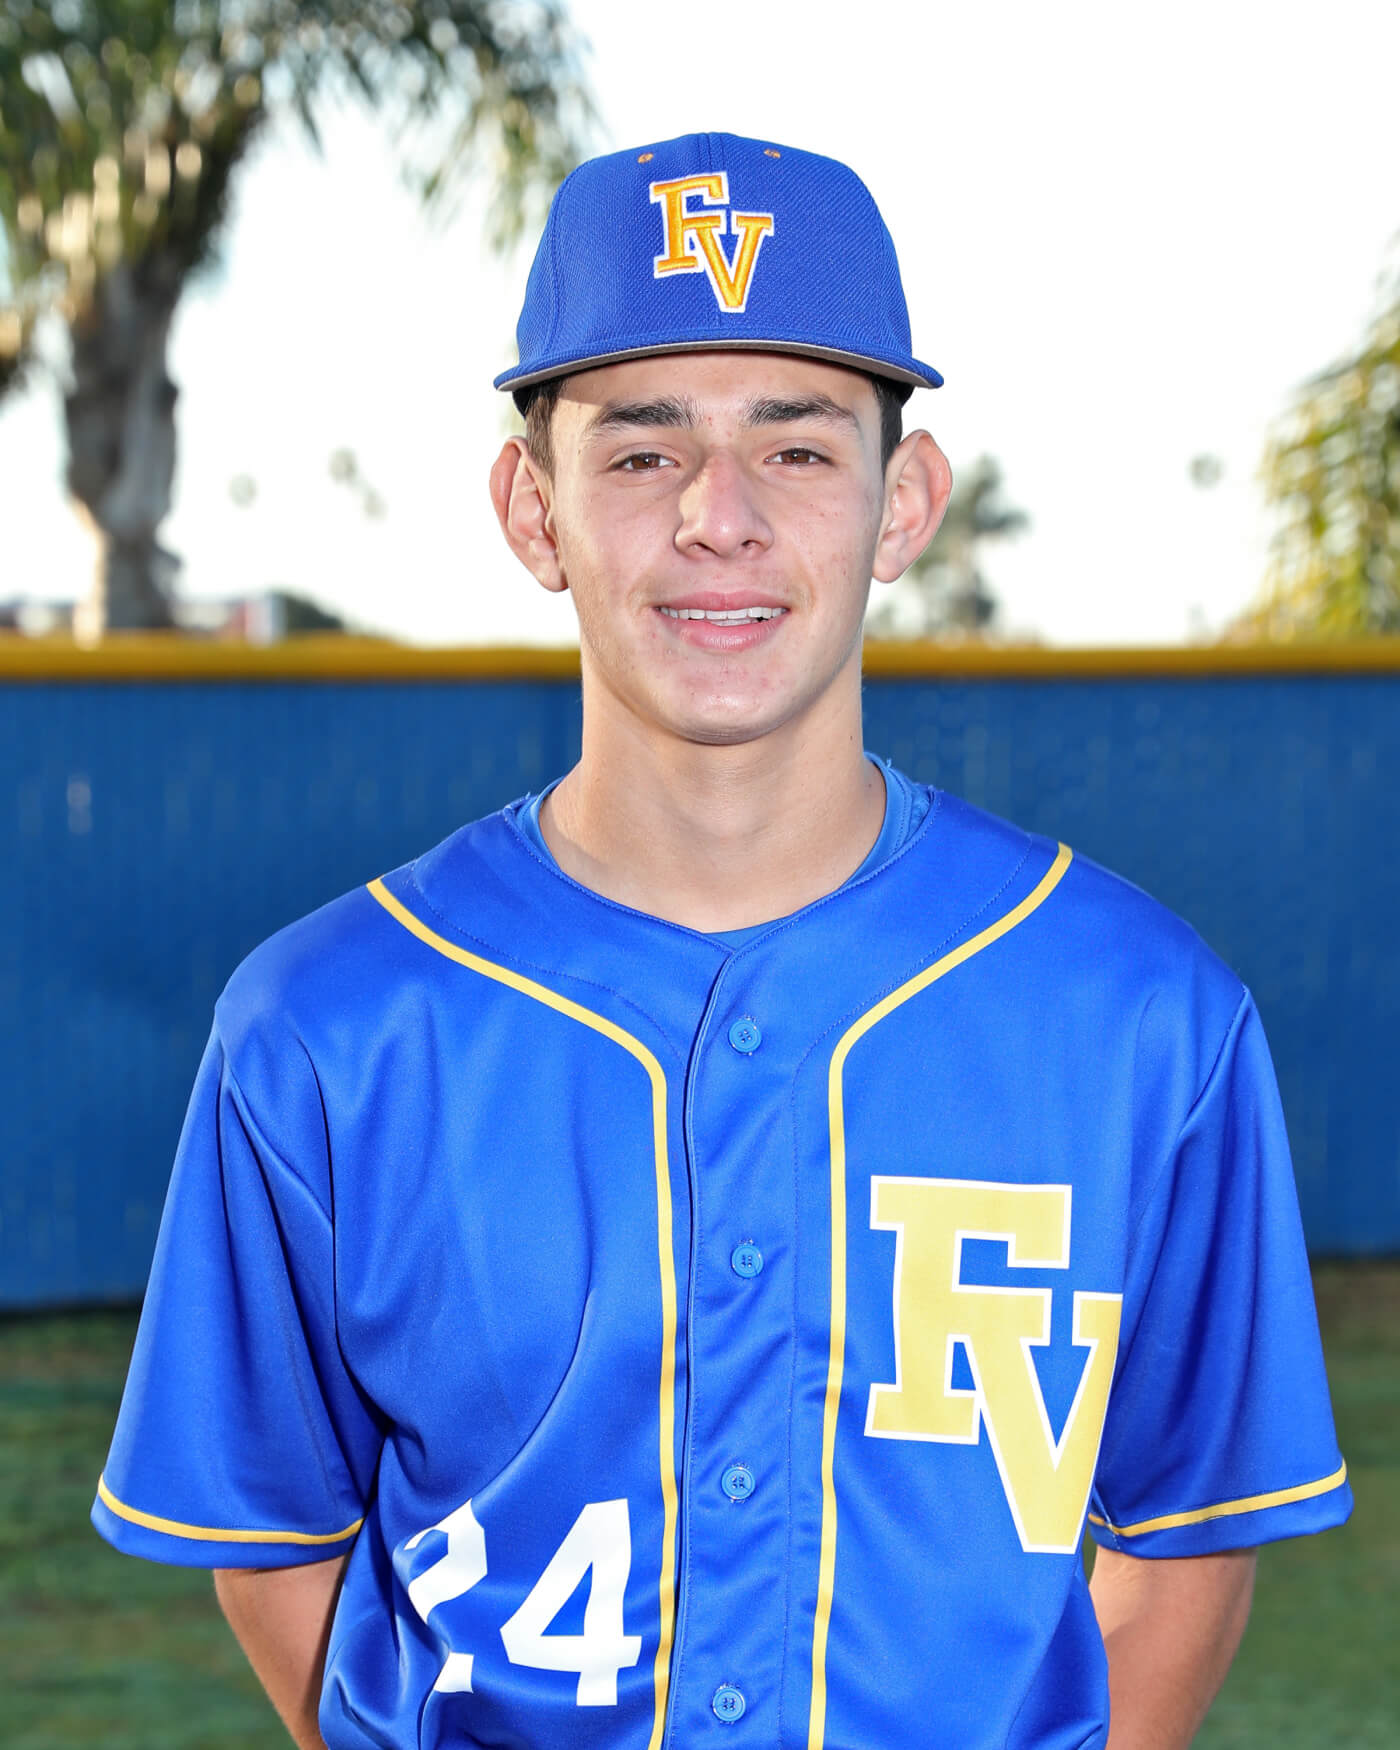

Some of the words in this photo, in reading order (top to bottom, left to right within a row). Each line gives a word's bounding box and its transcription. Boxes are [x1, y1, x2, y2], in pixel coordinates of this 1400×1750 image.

[649, 171, 775, 314] FV
[864, 1175, 1123, 1555] FV
[403, 1498, 642, 1706] 24
